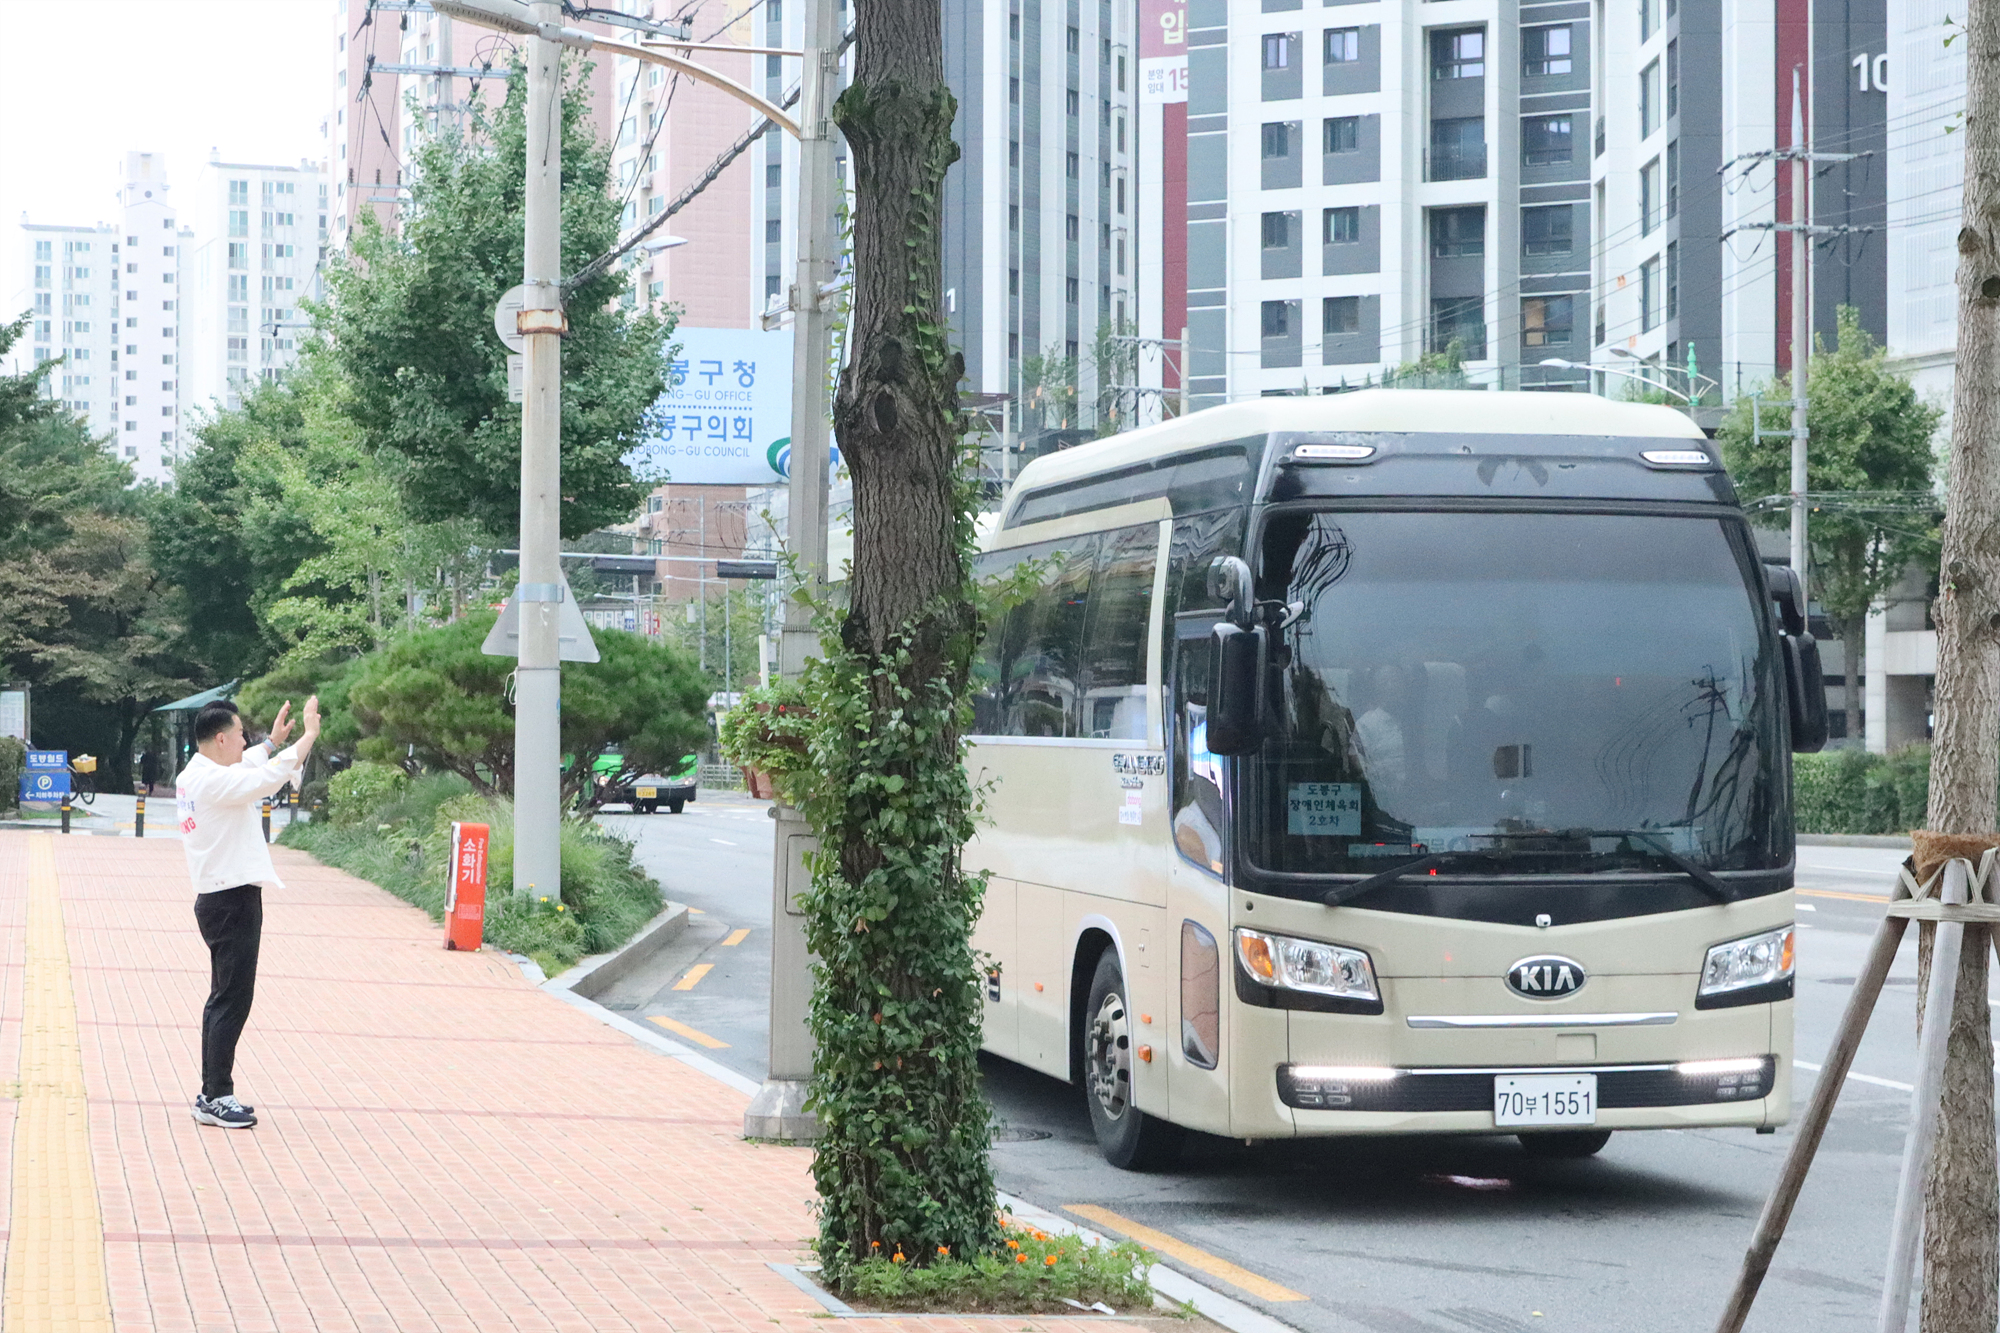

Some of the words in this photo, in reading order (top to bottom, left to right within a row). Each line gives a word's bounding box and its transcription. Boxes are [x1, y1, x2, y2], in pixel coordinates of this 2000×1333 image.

[1160, 9, 1188, 44] 입
[1148, 69, 1164, 80] 분양
[1147, 82, 1164, 94] 임대
[668, 359, 756, 388] 봉구청
[715, 390, 752, 401] OFFICE
[640, 415, 753, 443] 봉구의회
[704, 446, 750, 458] COUNCIL
[1307, 784, 1342, 796] 도봉구
[1309, 815, 1339, 827] 2호차
[462, 838, 476, 884] 소화기
[1520, 965, 1576, 991] KIA
